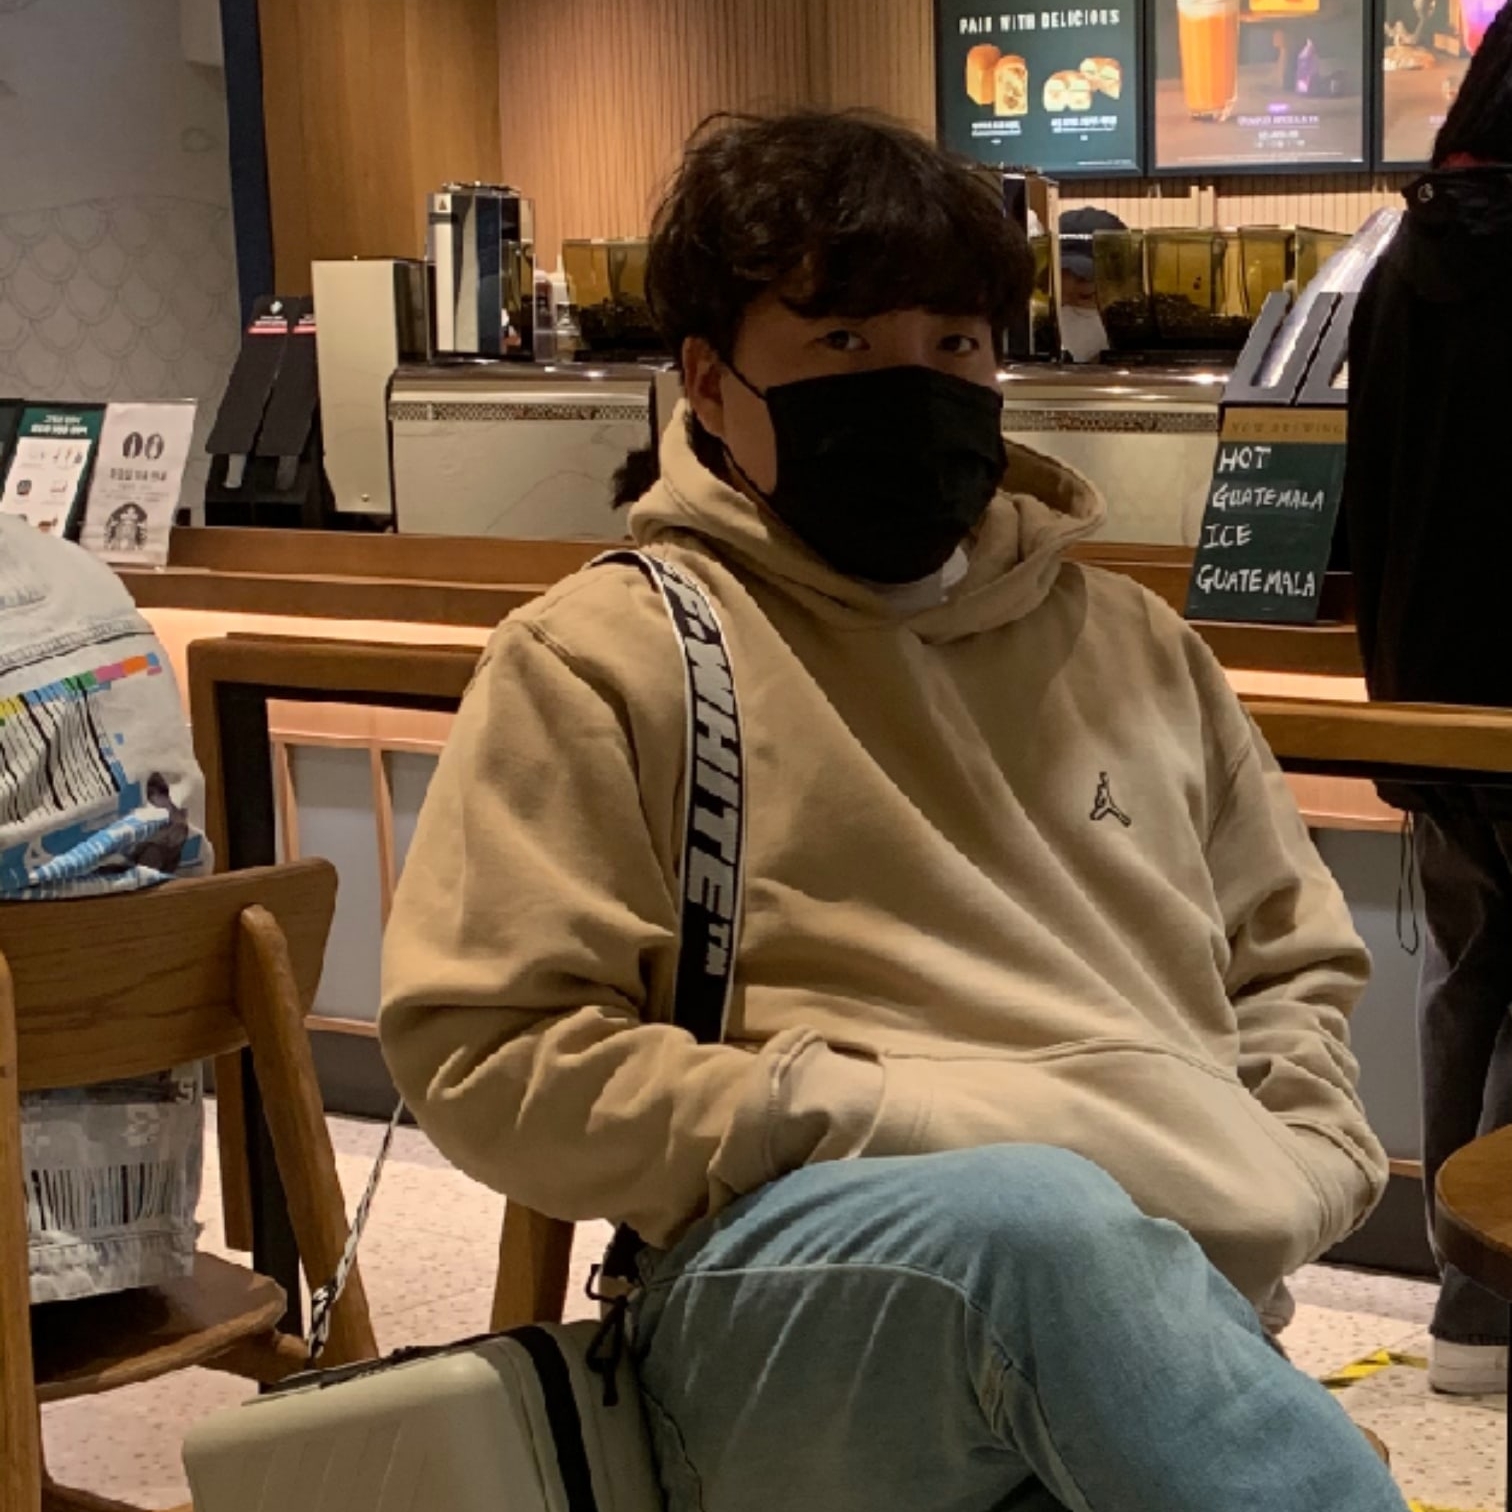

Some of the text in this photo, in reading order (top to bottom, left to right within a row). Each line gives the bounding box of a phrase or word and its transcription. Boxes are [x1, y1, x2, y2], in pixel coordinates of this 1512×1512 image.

[1000, 13, 1035, 32] WITH
[1041, 9, 1120, 29] DELICIOUS
[1216, 445, 1271, 473] HOT
[1212, 483, 1325, 512] GUATEMALA
[1203, 523, 1252, 549] ICE
[1195, 564, 1316, 597] GUATEMALA
